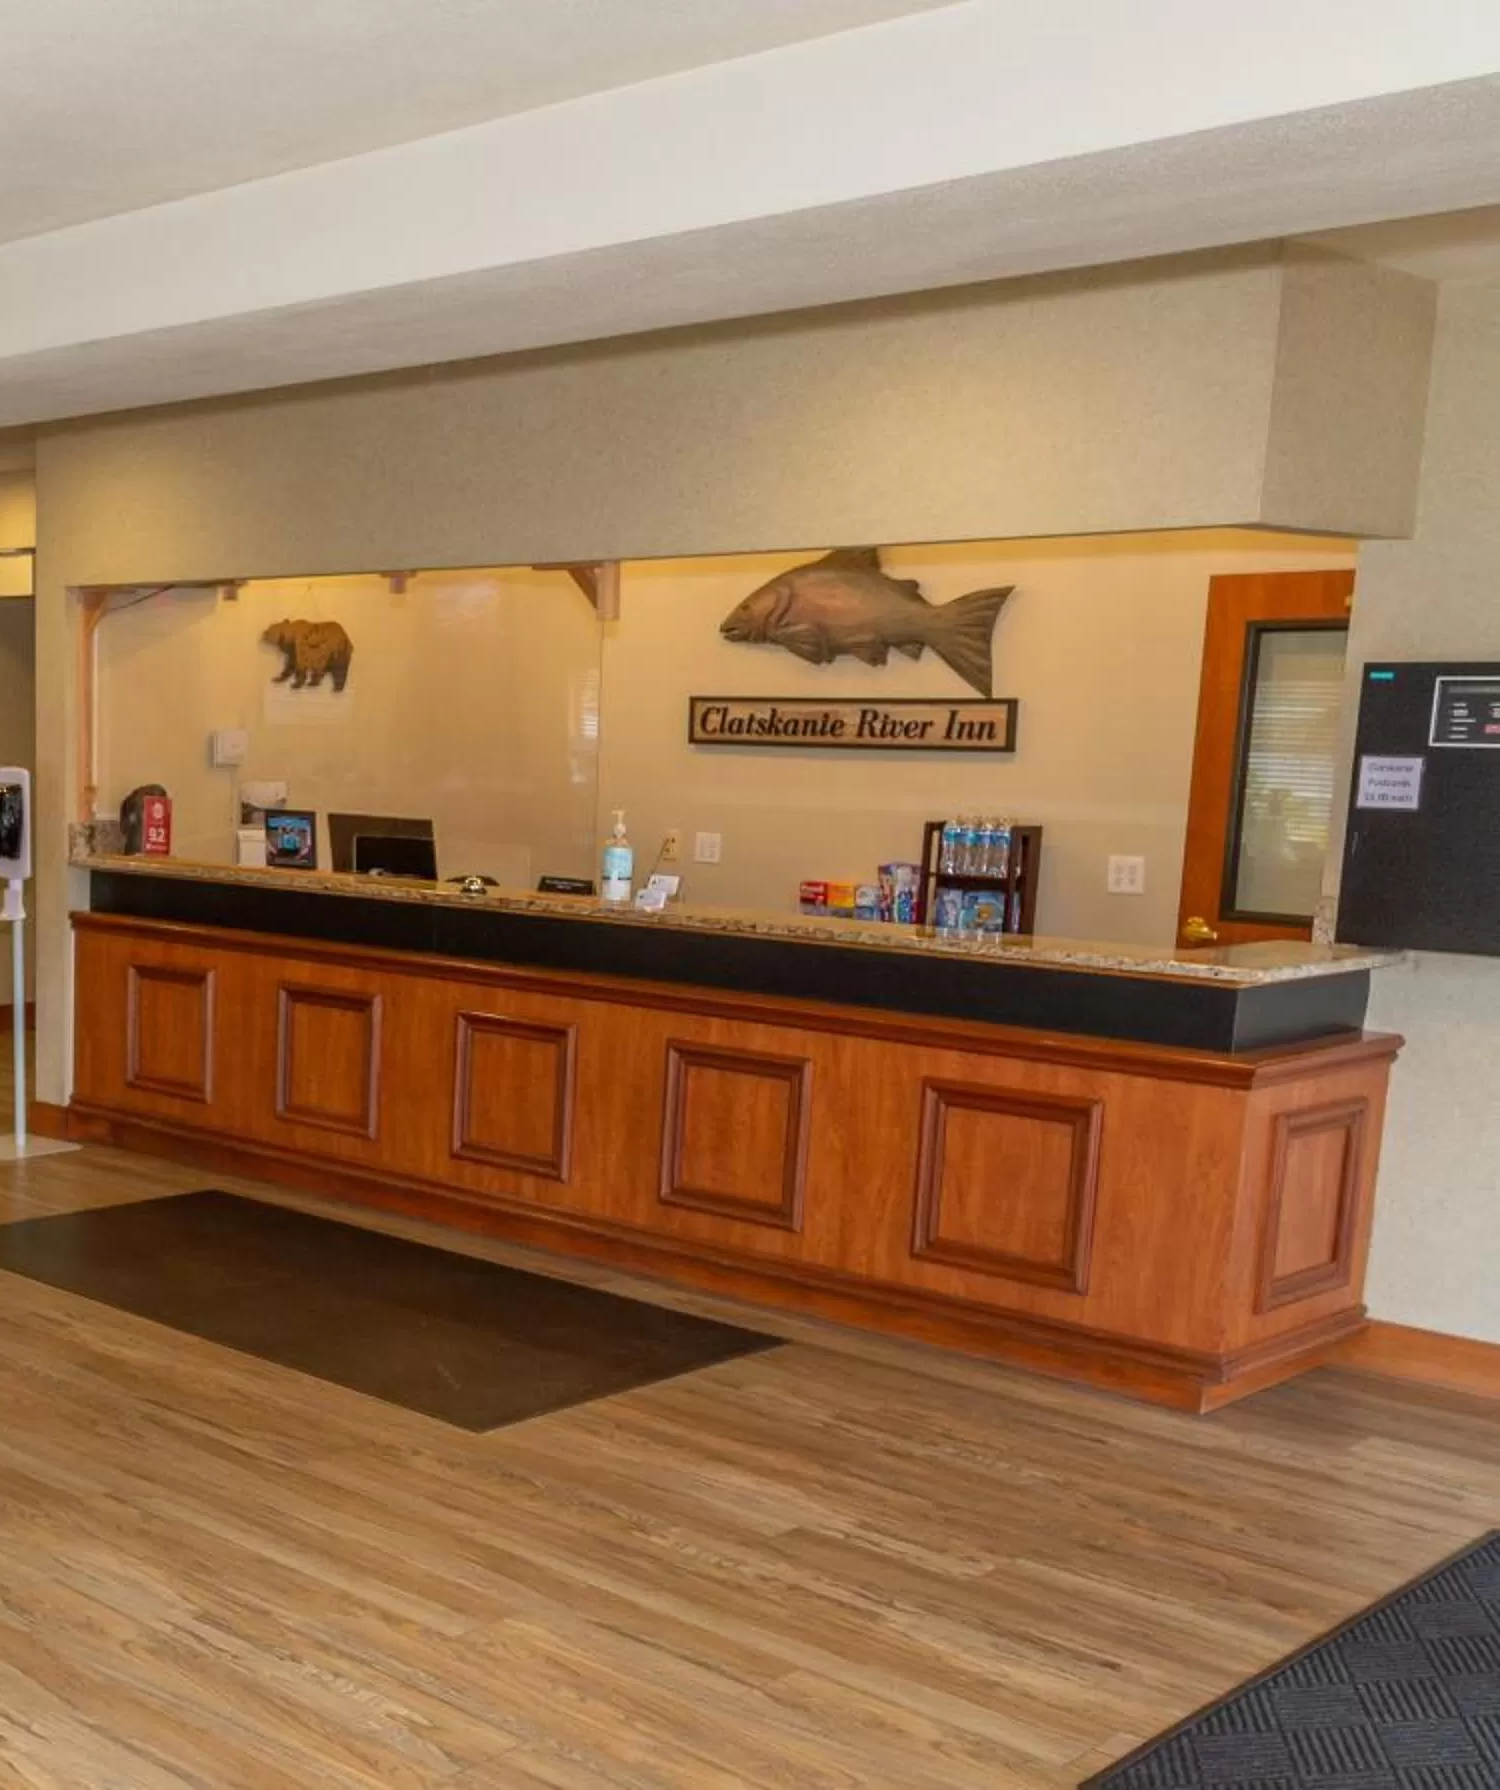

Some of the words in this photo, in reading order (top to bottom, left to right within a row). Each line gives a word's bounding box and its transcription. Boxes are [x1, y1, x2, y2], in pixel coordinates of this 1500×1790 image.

[700, 705, 845, 738] Clatskanie
[856, 707, 935, 741] River
[943, 709, 997, 741] Inn
